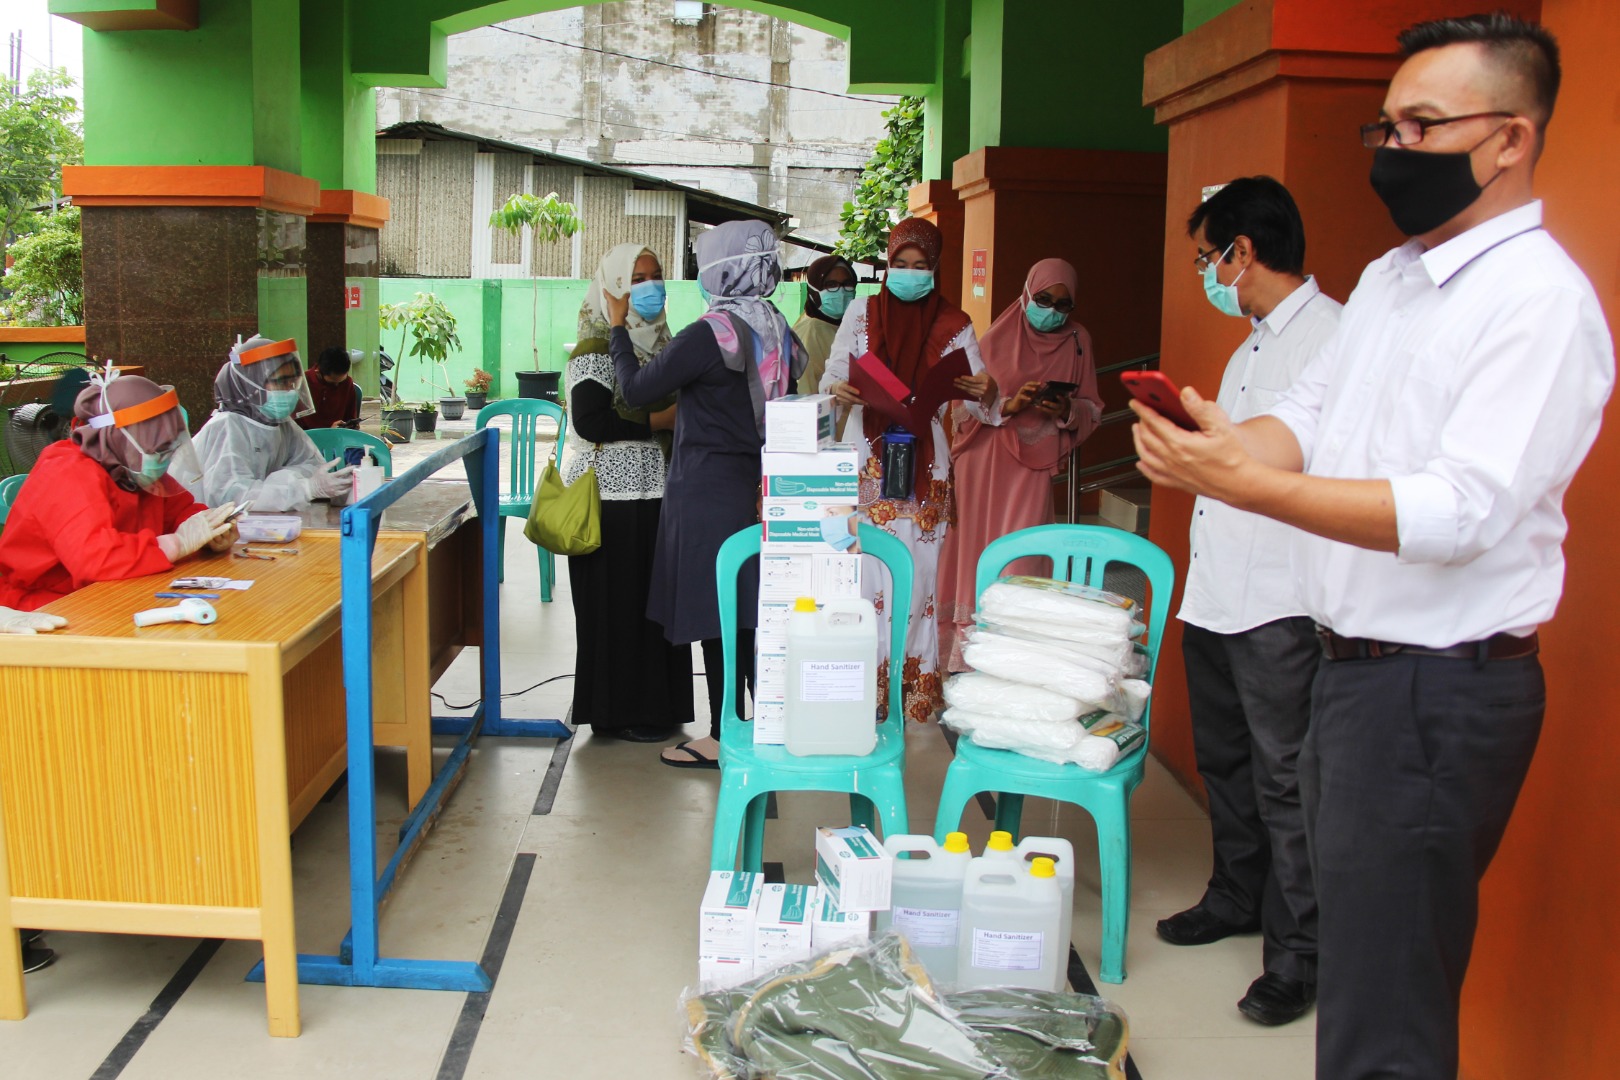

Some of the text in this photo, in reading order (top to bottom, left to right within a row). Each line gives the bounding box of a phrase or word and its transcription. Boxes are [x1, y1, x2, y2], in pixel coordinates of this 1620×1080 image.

[810, 663, 861, 671] Hand Sanitizer
[903, 909, 952, 919] Hand Sanitizer
[983, 931, 1033, 941] Hand Sanitizer
